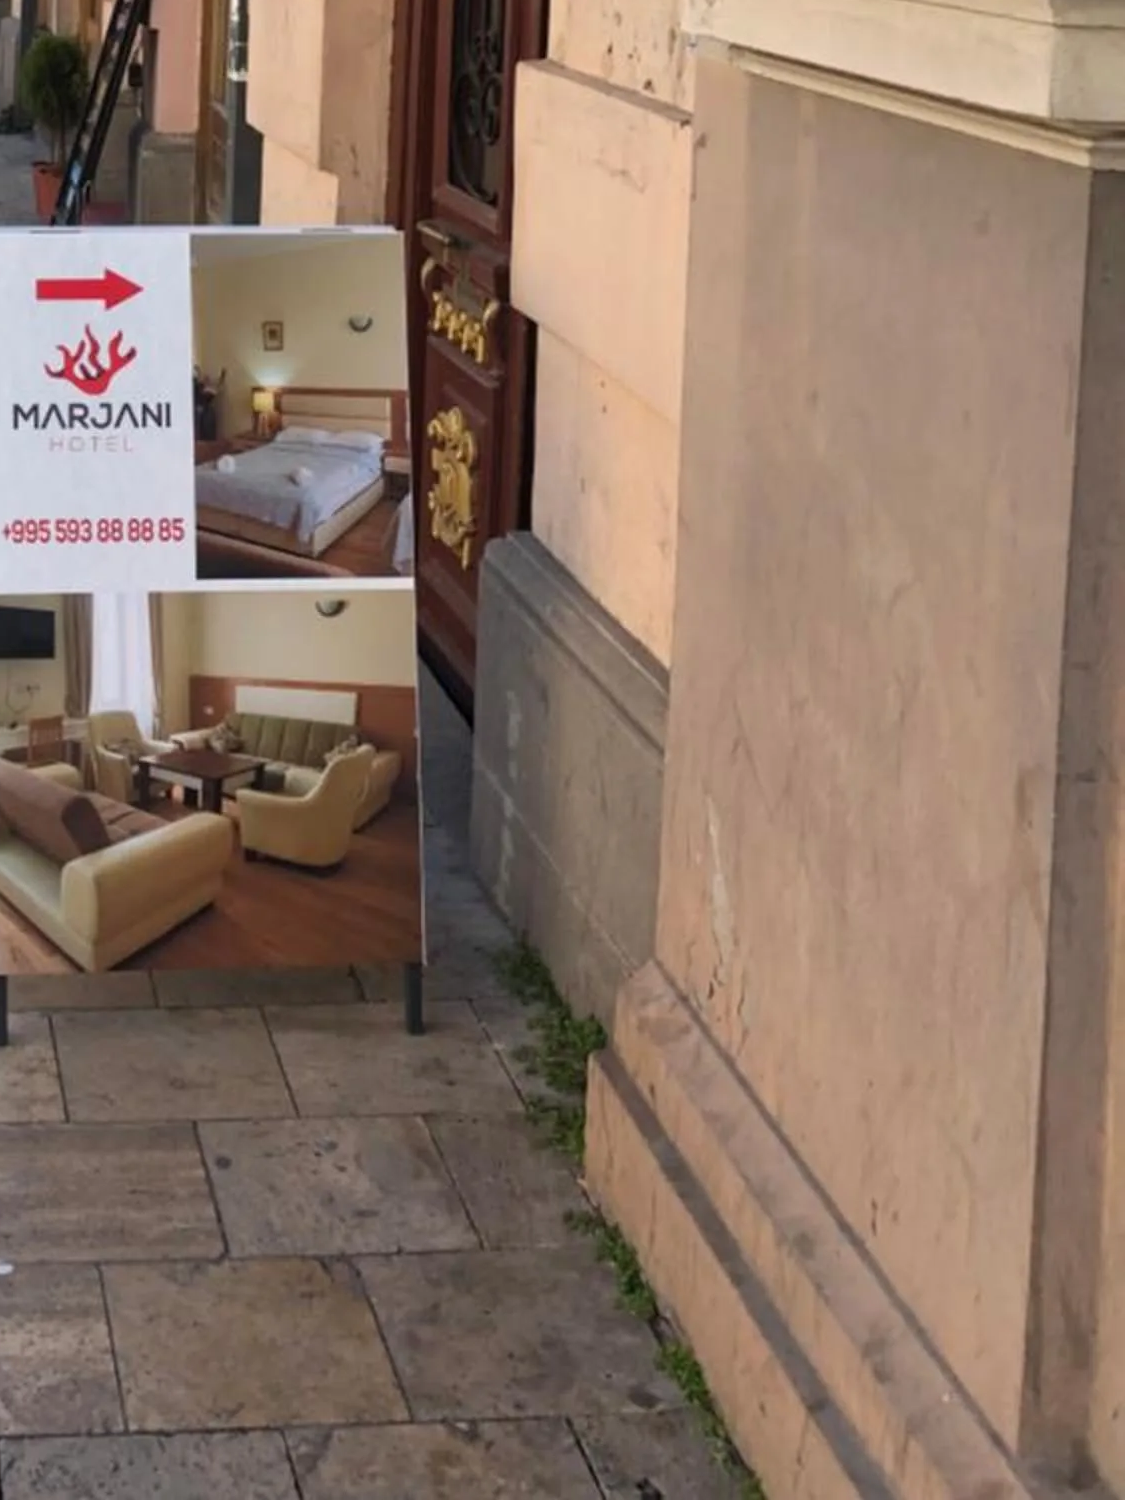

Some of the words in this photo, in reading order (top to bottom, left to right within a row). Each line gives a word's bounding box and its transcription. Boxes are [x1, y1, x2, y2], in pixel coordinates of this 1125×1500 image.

[12, 402, 172, 430] MARJANI
[49, 435, 134, 453] HOTEL
[3, 519, 51, 544] +995
[55, 519, 92, 544] 593
[97, 518, 124, 543] 88
[128, 518, 154, 543] 88
[159, 518, 186, 542] 85
